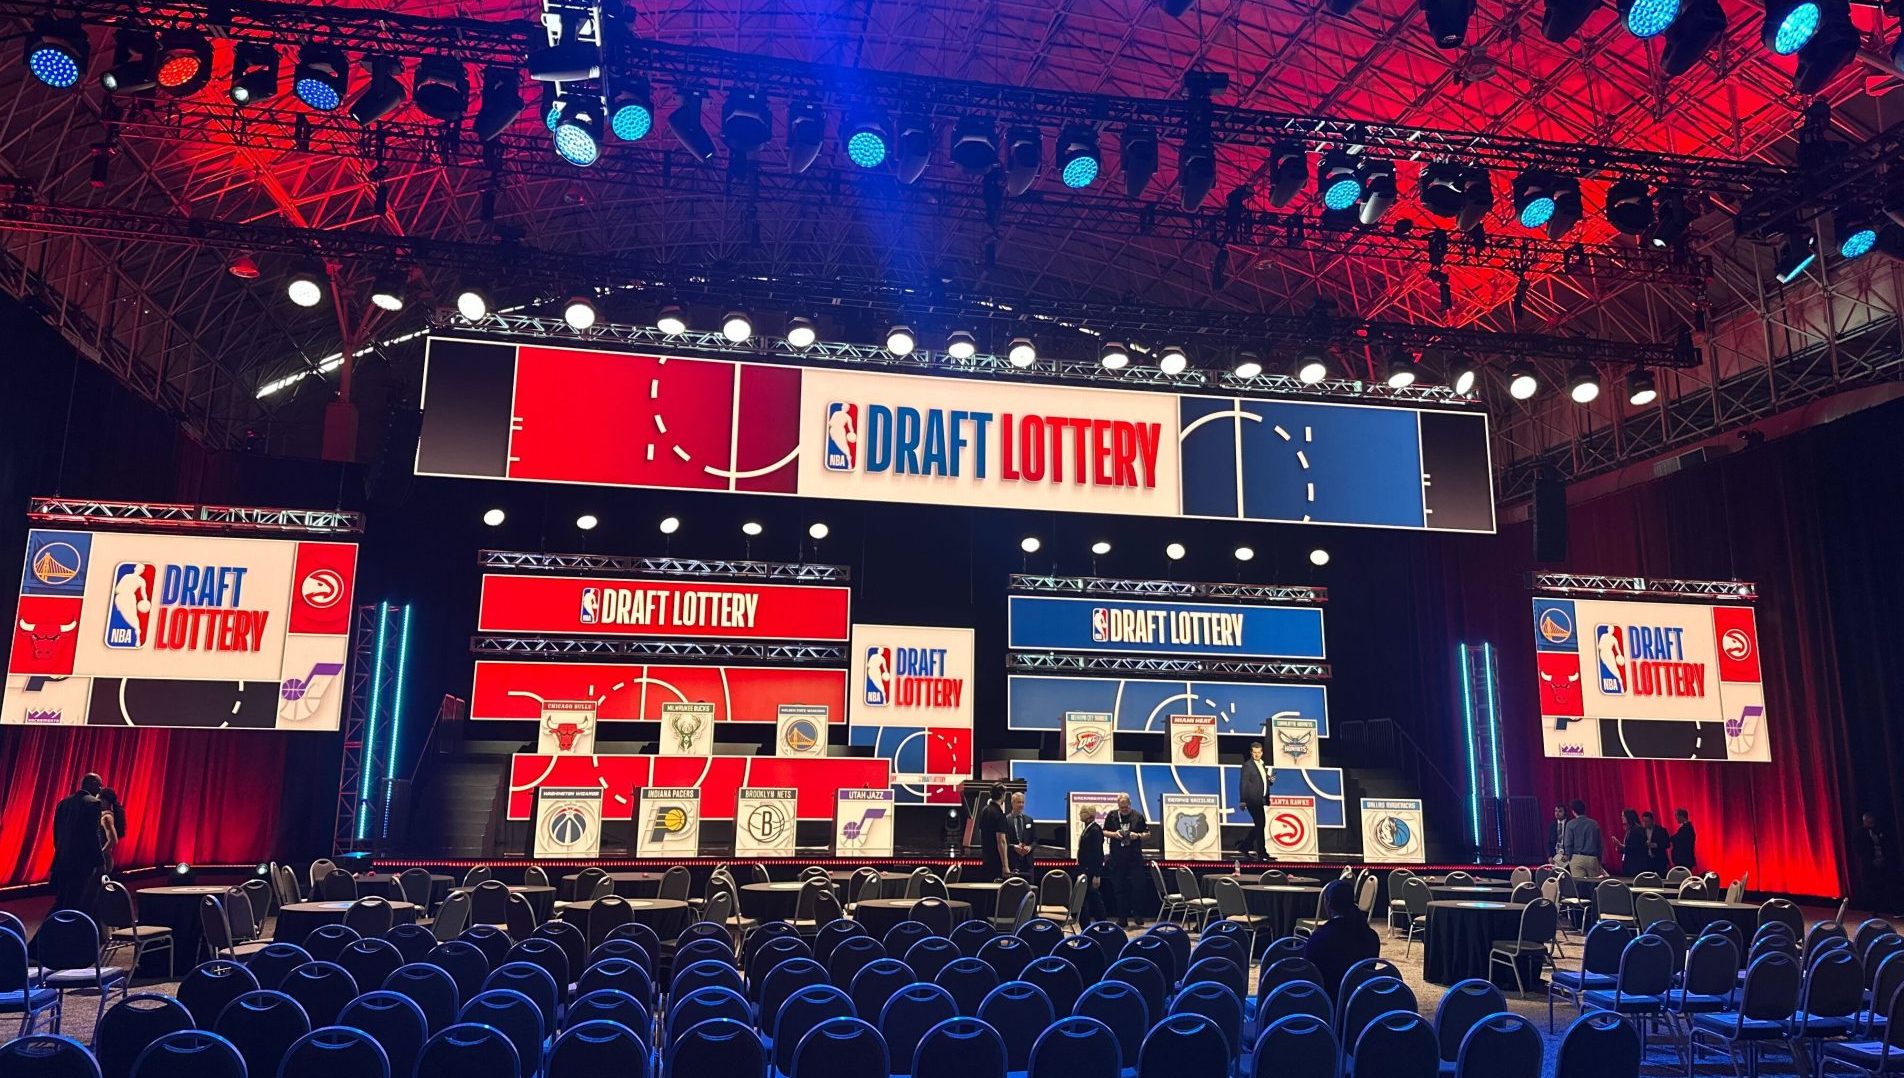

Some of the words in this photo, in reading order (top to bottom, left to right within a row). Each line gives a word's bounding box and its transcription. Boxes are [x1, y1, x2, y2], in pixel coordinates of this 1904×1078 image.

[829, 454, 845, 467] NBA
[867, 404, 993, 479] DRAFT
[1002, 413, 1162, 489] LOTTERY
[162, 564, 248, 608] DRAFT
[601, 588, 670, 626] DRAFT
[672, 590, 759, 628] LOTTERY
[111, 628, 132, 644] NBA
[155, 607, 270, 653] LOTTERY
[1110, 608, 1167, 644] DRAFT
[1170, 610, 1244, 647] LOTTERY
[1628, 625, 1684, 660] DRAFT
[896, 647, 947, 677] DRAFT
[894, 677, 963, 708] LOTTERY
[1603, 678, 1618, 691] NBA
[1631, 661, 1705, 697] LOTTERY
[867, 691, 881, 703] NBA
[648, 790, 671, 798] INDIANA
[672, 790, 694, 798] PACERS
[745, 790, 775, 798] BROOKLYN
[776, 790, 792, 799] NETS
[848, 791, 865, 799] UTAH
[867, 792, 884, 800] JAZZ
